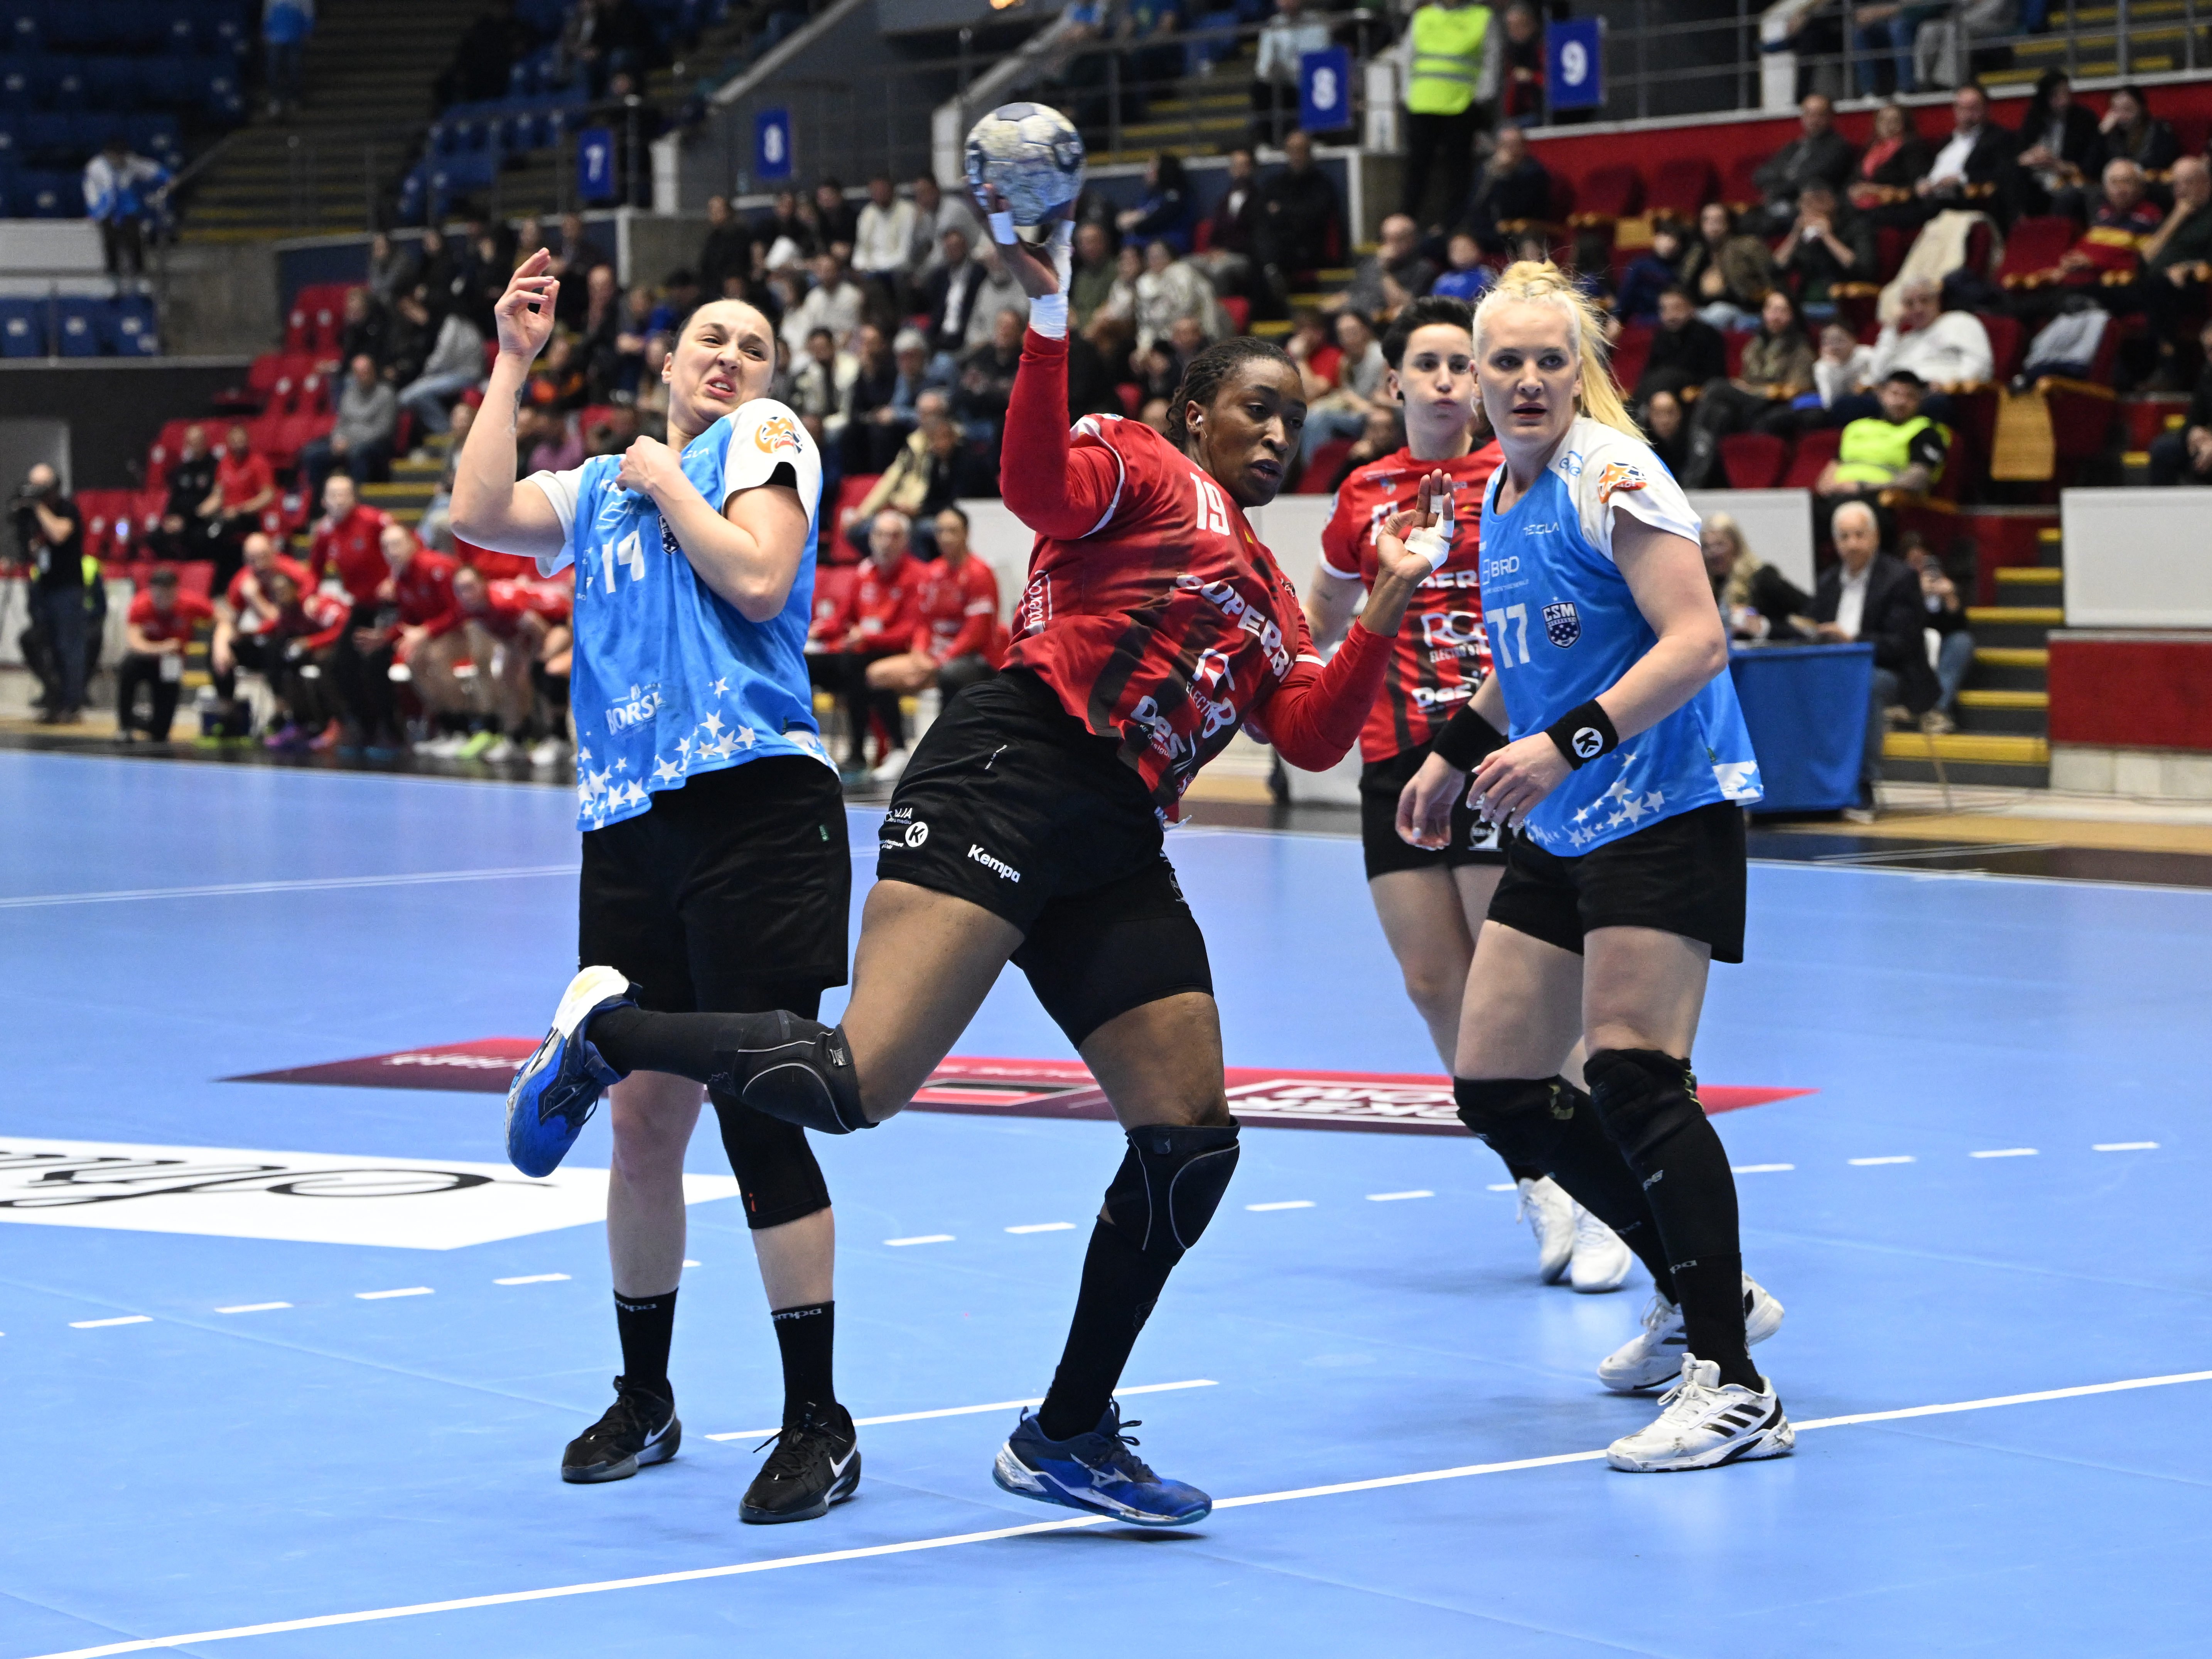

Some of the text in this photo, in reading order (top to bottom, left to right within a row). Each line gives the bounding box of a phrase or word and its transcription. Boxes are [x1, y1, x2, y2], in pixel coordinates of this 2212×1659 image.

[1561, 41, 1587, 86] 9
[1313, 67, 1338, 111] 8
[586, 143, 605, 182] 7
[1190, 472, 1230, 536] 19
[1491, 556, 1520, 577] BRD
[1170, 574, 1294, 683] SUPERB
[1543, 603, 1576, 622] CSM
[1485, 603, 1530, 668] 77
[967, 844, 1020, 883] Kempa
[773, 1308, 822, 1320] empa
